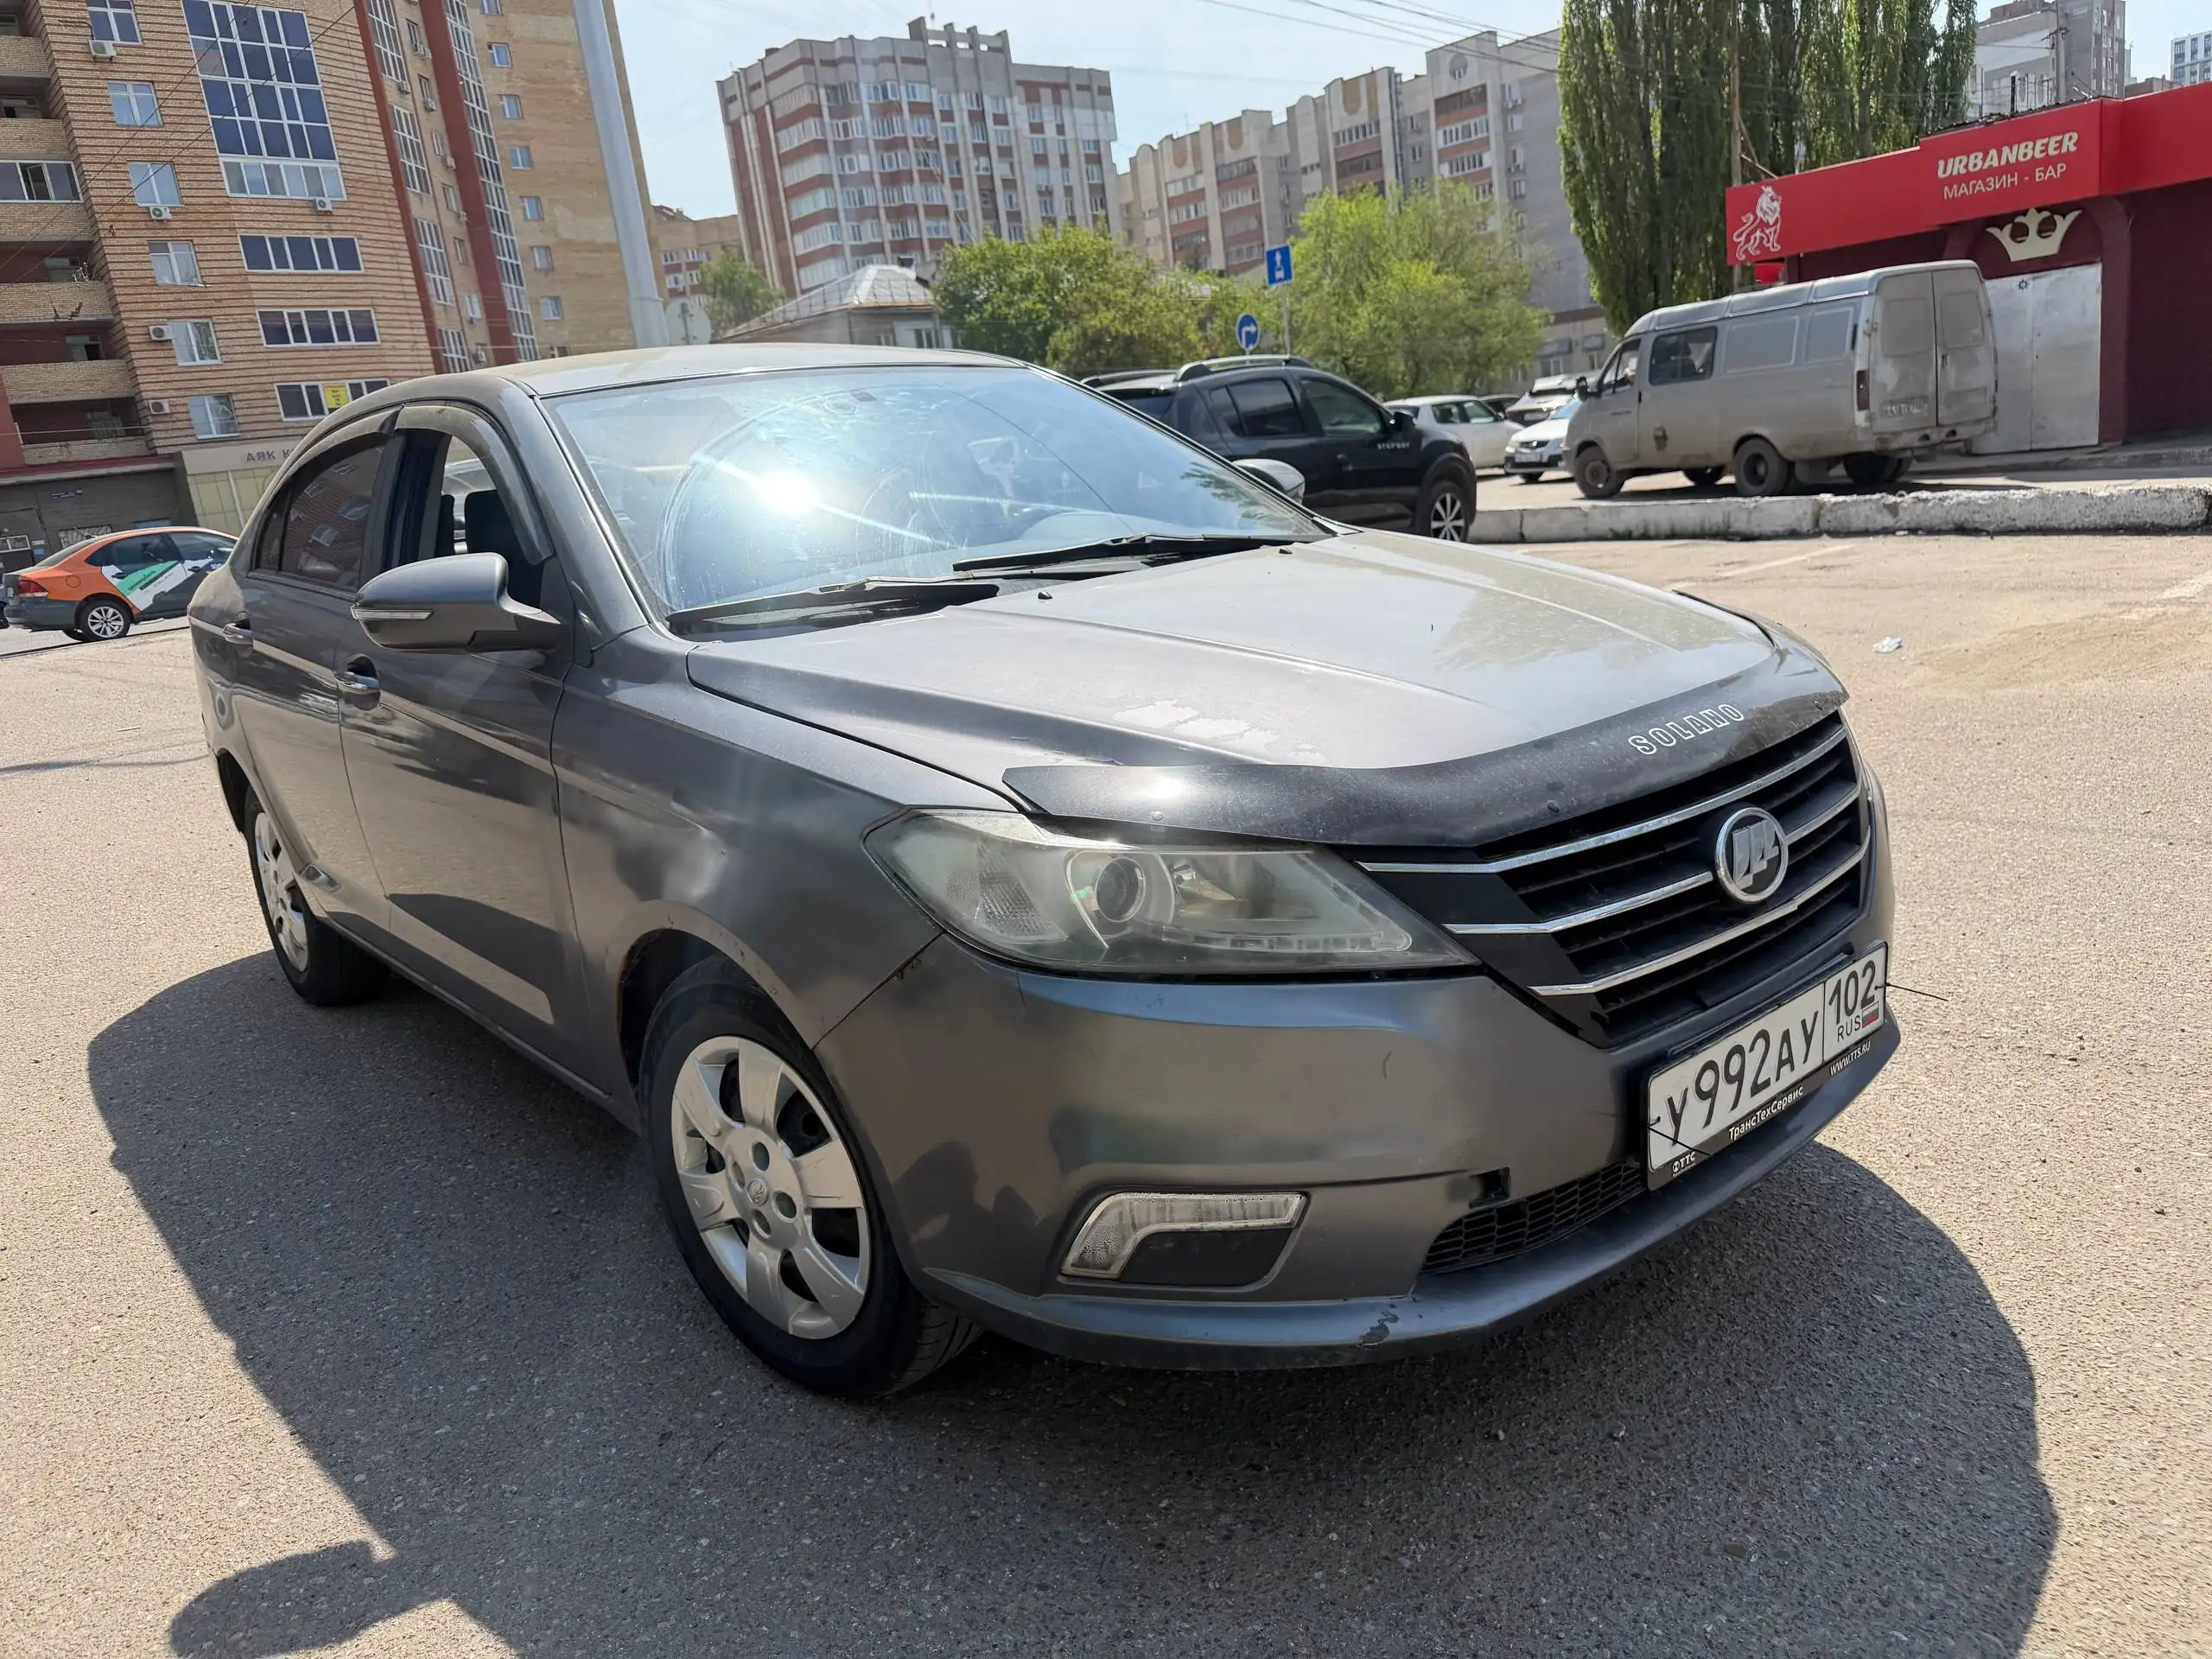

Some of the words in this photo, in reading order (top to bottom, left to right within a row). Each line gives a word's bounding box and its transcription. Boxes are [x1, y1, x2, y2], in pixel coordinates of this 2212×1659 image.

[1936, 131, 2079, 179] URBANBEER
[1943, 172, 2018, 200] МАГАЗИН
[2035, 163, 2067, 182] БАР
[1628, 703, 1745, 755] SOLANO
[1828, 959, 1876, 1025] 102
[1837, 1014, 1861, 1043] RUS
[1728, 1086, 1803, 1141] ТрансТехСервис
